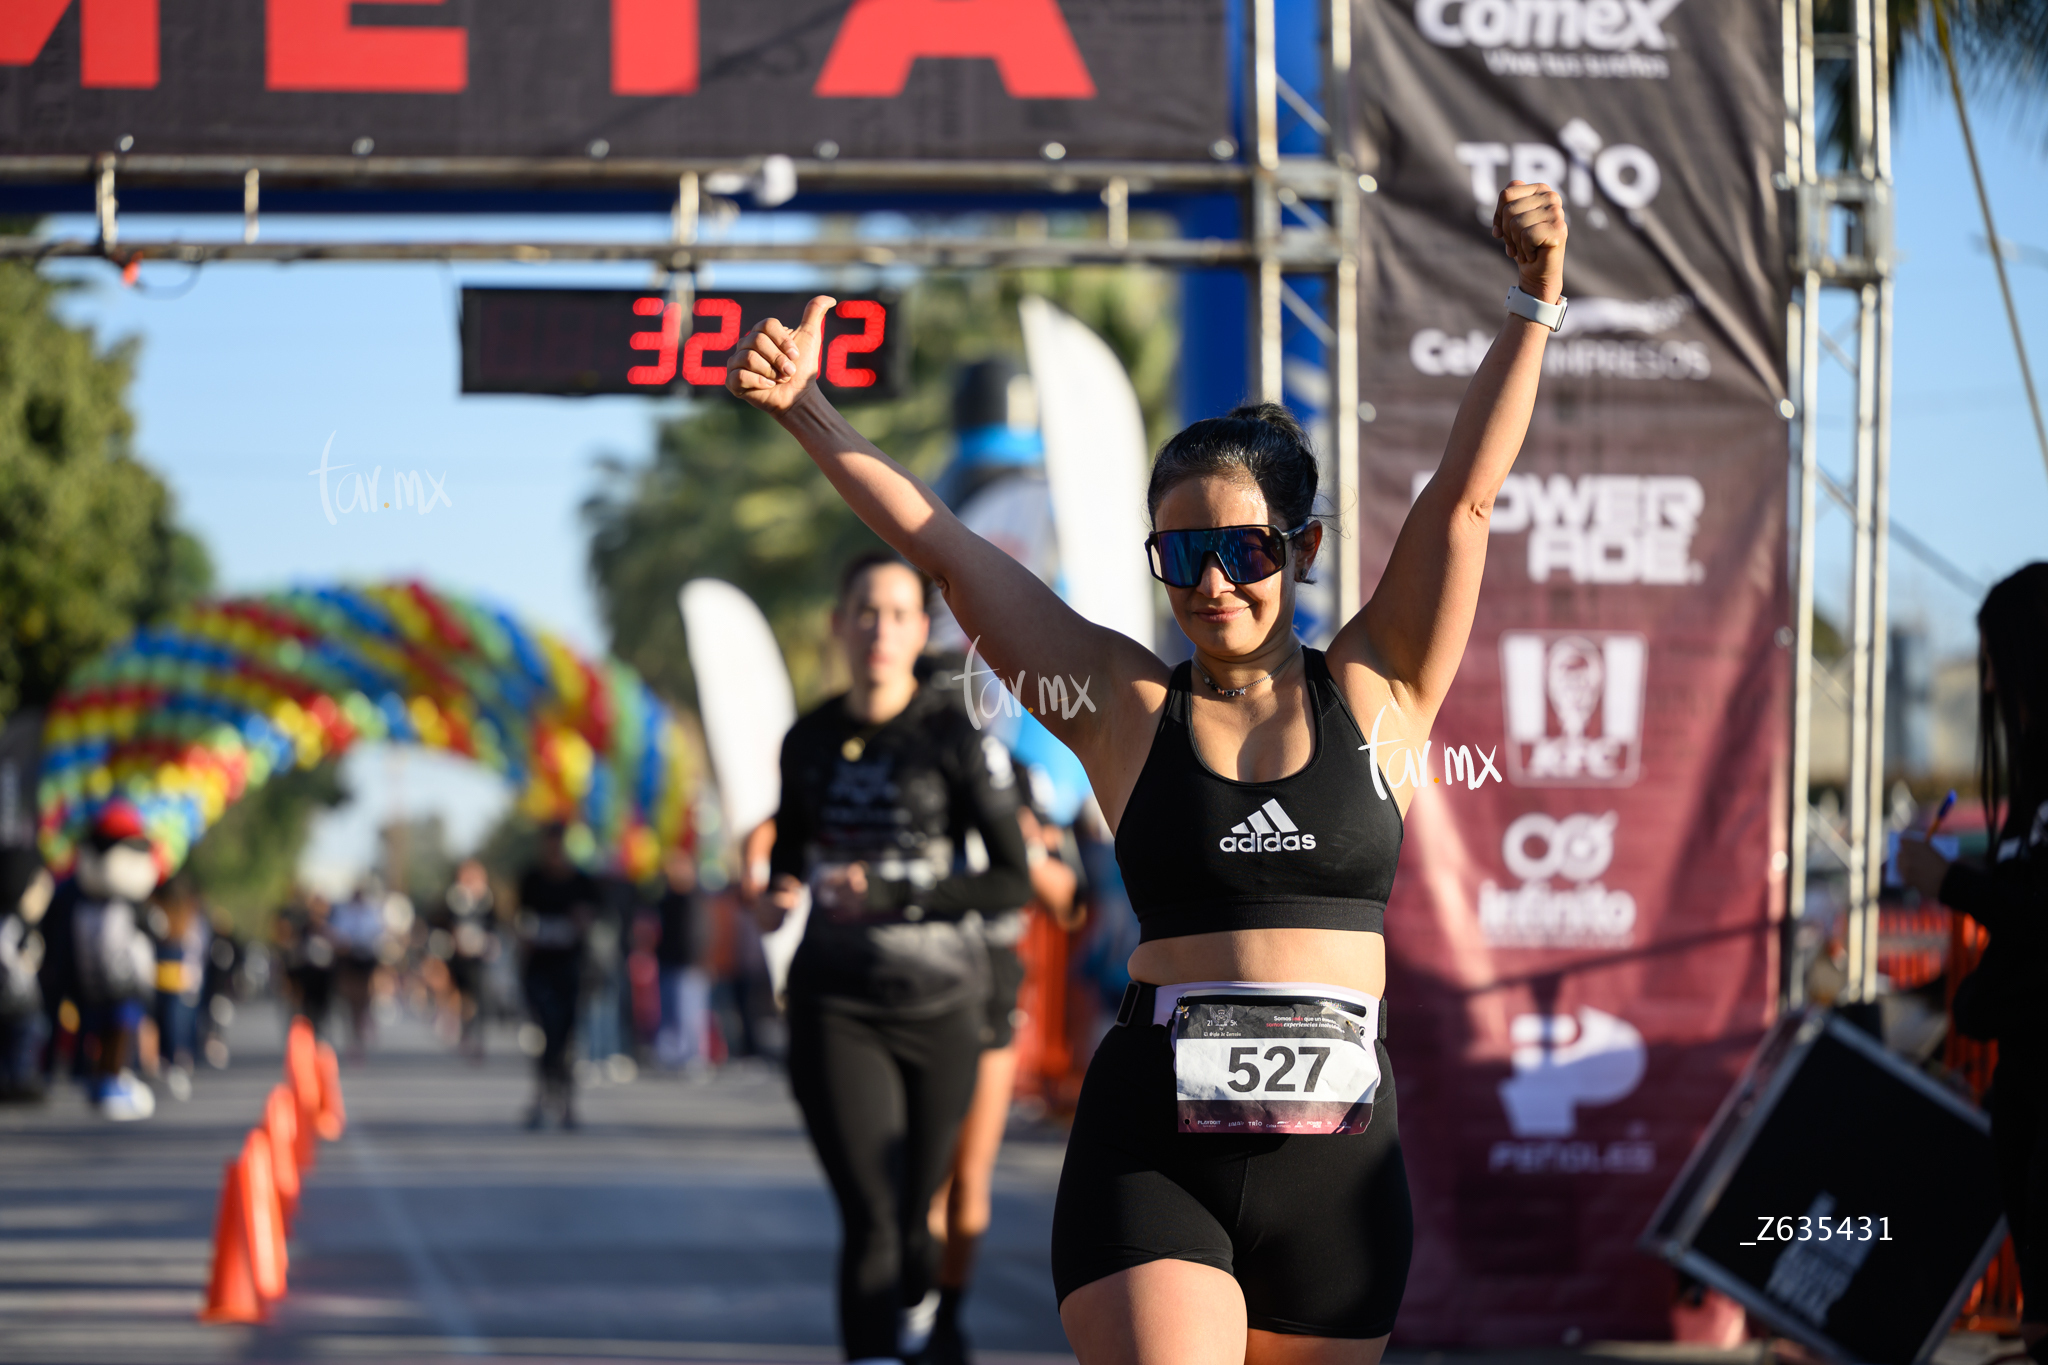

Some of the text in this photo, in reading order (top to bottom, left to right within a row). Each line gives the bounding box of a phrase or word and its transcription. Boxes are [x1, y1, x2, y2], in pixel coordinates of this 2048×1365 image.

[1411, 472, 1704, 534] OWER
[1219, 831, 1316, 852] adidas
[1227, 1046, 1331, 1093] 527
